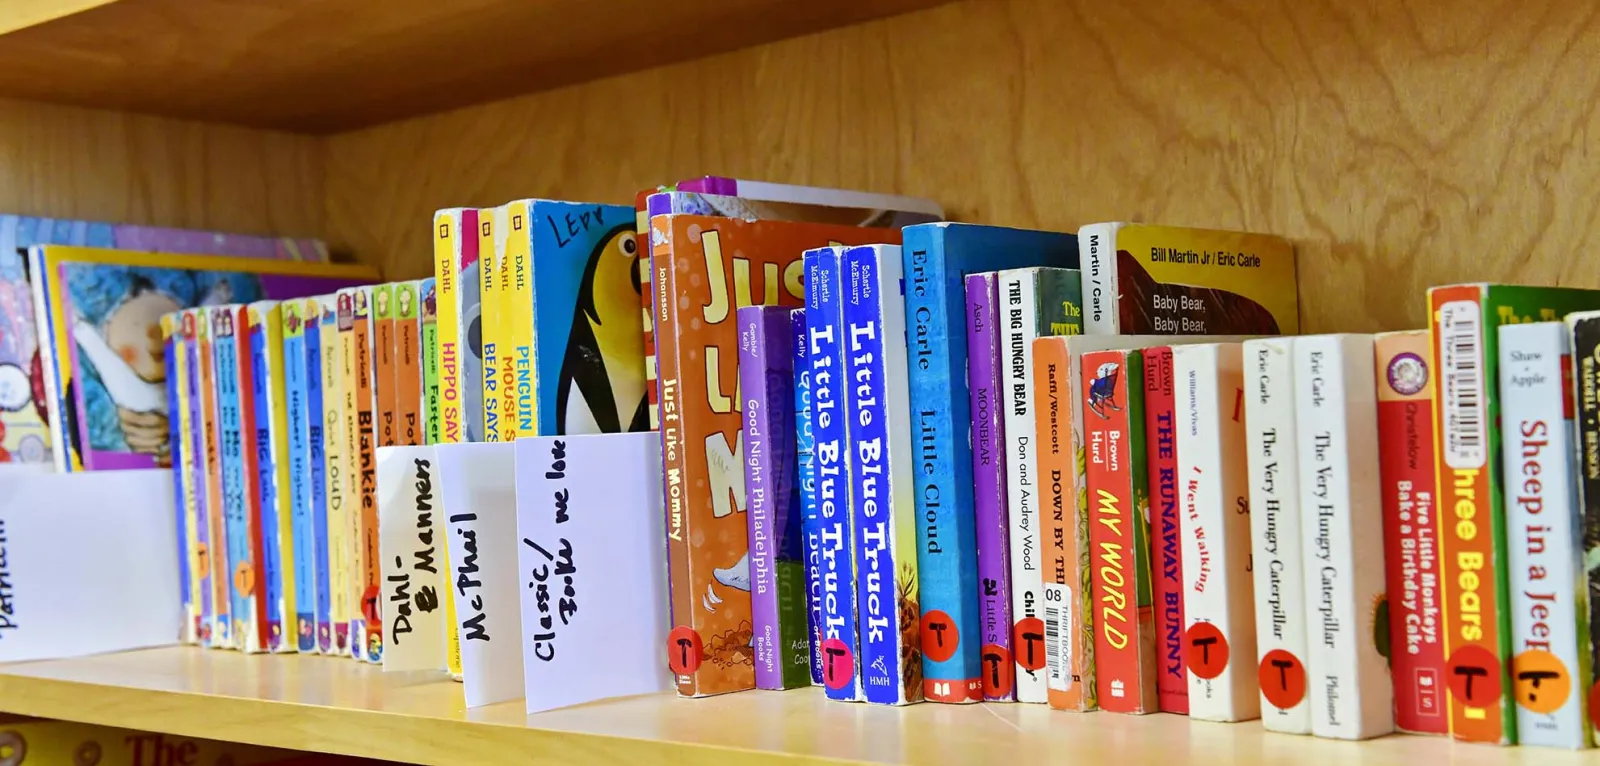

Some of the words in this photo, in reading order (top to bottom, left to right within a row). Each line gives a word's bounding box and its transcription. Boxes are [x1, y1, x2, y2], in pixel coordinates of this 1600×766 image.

[484, 257, 492, 291] DAHL
[501, 255, 509, 291] DAHL
[516, 254, 524, 290] DAHL
[912, 249, 929, 296] Eric
[1090, 234, 1100, 276] Martin
[1151, 247, 1167, 262] Bill
[1168, 248, 1199, 265] Martin
[1200, 250, 1211, 265] Jr
[1212, 251, 1216, 265] /
[1217, 251, 1235, 266] Eric
[1237, 252, 1260, 268] Carle
[441, 259, 451, 293] DAHL
[659, 266, 668, 322] Johansson
[811, 265, 820, 310] McElmurry
[821, 270, 829, 302] Schertle
[850, 260, 860, 305] McElmurry
[862, 265, 871, 298] Schertle
[1009, 280, 1021, 305] THE
[973, 302, 984, 333] Asch
[1011, 309, 1022, 329] BIG
[1062, 300, 1080, 317] The
[1092, 287, 1103, 322] Carle
[1153, 295, 1178, 312] Baby
[1180, 295, 1206, 312] Bear,
[750, 322, 758, 358] Gamble/
[915, 306, 932, 370] Carle
[1154, 316, 1179, 333] Baby
[1182, 317, 1207, 334] Bear,
[358, 333, 368, 389] Patricelli
[797, 334, 806, 358] Kelly
[1011, 333, 1024, 380] HUNGRY
[1259, 350, 1269, 373] Eric
[1310, 351, 1324, 374] Eric
[1511, 350, 1542, 362] Shaw
[442, 342, 457, 401] HIPPO
[484, 343, 497, 391] BEAR
[810, 325, 834, 428] Little
[850, 321, 875, 427] Little
[1147, 355, 1159, 391] Hurd
[1162, 351, 1173, 396] Brown
[1511, 375, 1546, 388] Apple
[502, 356, 515, 425] MOUSE
[516, 346, 532, 430] PENGUIN
[664, 378, 678, 421] Just
[1013, 384, 1026, 416] BEAR
[1189, 370, 1199, 436] Williams/Vivas
[1260, 375, 1270, 404] Carle
[1312, 378, 1324, 407] Carle
[430, 385, 438, 443] Faster
[486, 398, 498, 442] SAYS
[748, 399, 760, 436] Good
[978, 388, 990, 465] MOONBEAR
[1048, 364, 1059, 454] Raffi/Westcott
[666, 428, 677, 461] Like
[919, 411, 939, 475] Little
[1018, 436, 1029, 459] Don
[1091, 431, 1103, 464] Hurd
[1109, 430, 1121, 471] Brown
[1158, 411, 1173, 459] THE
[1262, 428, 1276, 457] The
[1315, 431, 1331, 461] The
[1405, 401, 1421, 470] Christelow
[358, 411, 375, 510] Blankie
[545, 439, 566, 480] love
[749, 441, 762, 483] Night
[818, 439, 840, 518] Blue
[858, 438, 881, 519] Blue
[1020, 464, 1031, 486] and
[1261, 462, 1278, 494] Very
[1517, 420, 1548, 515] Sheep
[329, 455, 342, 511] LOUD
[1052, 470, 1063, 521] DOWN
[1313, 466, 1333, 499] Very
[1397, 480, 1413, 521] Bake
[414, 457, 437, 574] Manners
[554, 488, 570, 524] we
[667, 468, 682, 541] Mommy
[925, 484, 942, 554] Cloud
[1019, 489, 1032, 532] Audrey
[1096, 488, 1121, 537] MY
[1161, 467, 1179, 583] RUNAWAY
[1416, 491, 1431, 525] Five
[1453, 468, 1480, 541] hree
[752, 487, 767, 594] Philadelphia
[1054, 528, 1063, 551] BY
[1187, 480, 1199, 521] Went
[1193, 526, 1210, 593] Walking
[1265, 499, 1281, 555] Hungry
[1316, 503, 1334, 564] Hungry
[1400, 524, 1412, 534] a
[1525, 525, 1551, 555] in
[1023, 537, 1034, 570] Wood
[1418, 528, 1435, 570] Little
[821, 522, 845, 640] Truck
[863, 522, 889, 643] Truck
[1400, 538, 1419, 610] Birthday
[1528, 566, 1547, 581] a
[387, 555, 413, 645] Dahl-
[986, 599, 996, 631] Little
[1024, 591, 1035, 618] Chil
[1045, 588, 1062, 602] 08
[1100, 542, 1128, 650] WORLD
[1268, 560, 1286, 640] Caterpillar
[1319, 566, 1339, 649] Caterpillar
[1421, 573, 1439, 643] Monkeys
[1456, 551, 1484, 641] Bears
[757, 636, 765, 662] Books
[764, 625, 772, 646] Good
[791, 639, 810, 650] Ada
[929, 623, 948, 648] T
[1022, 632, 1043, 666] T
[1165, 592, 1181, 678] BUNNY
[1192, 636, 1218, 666] T
[1406, 614, 1420, 655] Cake
[766, 648, 774, 673] Night
[825, 647, 847, 682] T
[869, 676, 890, 686] HMH
[983, 653, 1002, 689] T
[1271, 660, 1294, 692] T
[1326, 675, 1340, 726] Philomel
[1453, 665, 1488, 700] T
[124, 735, 199, 766] The
